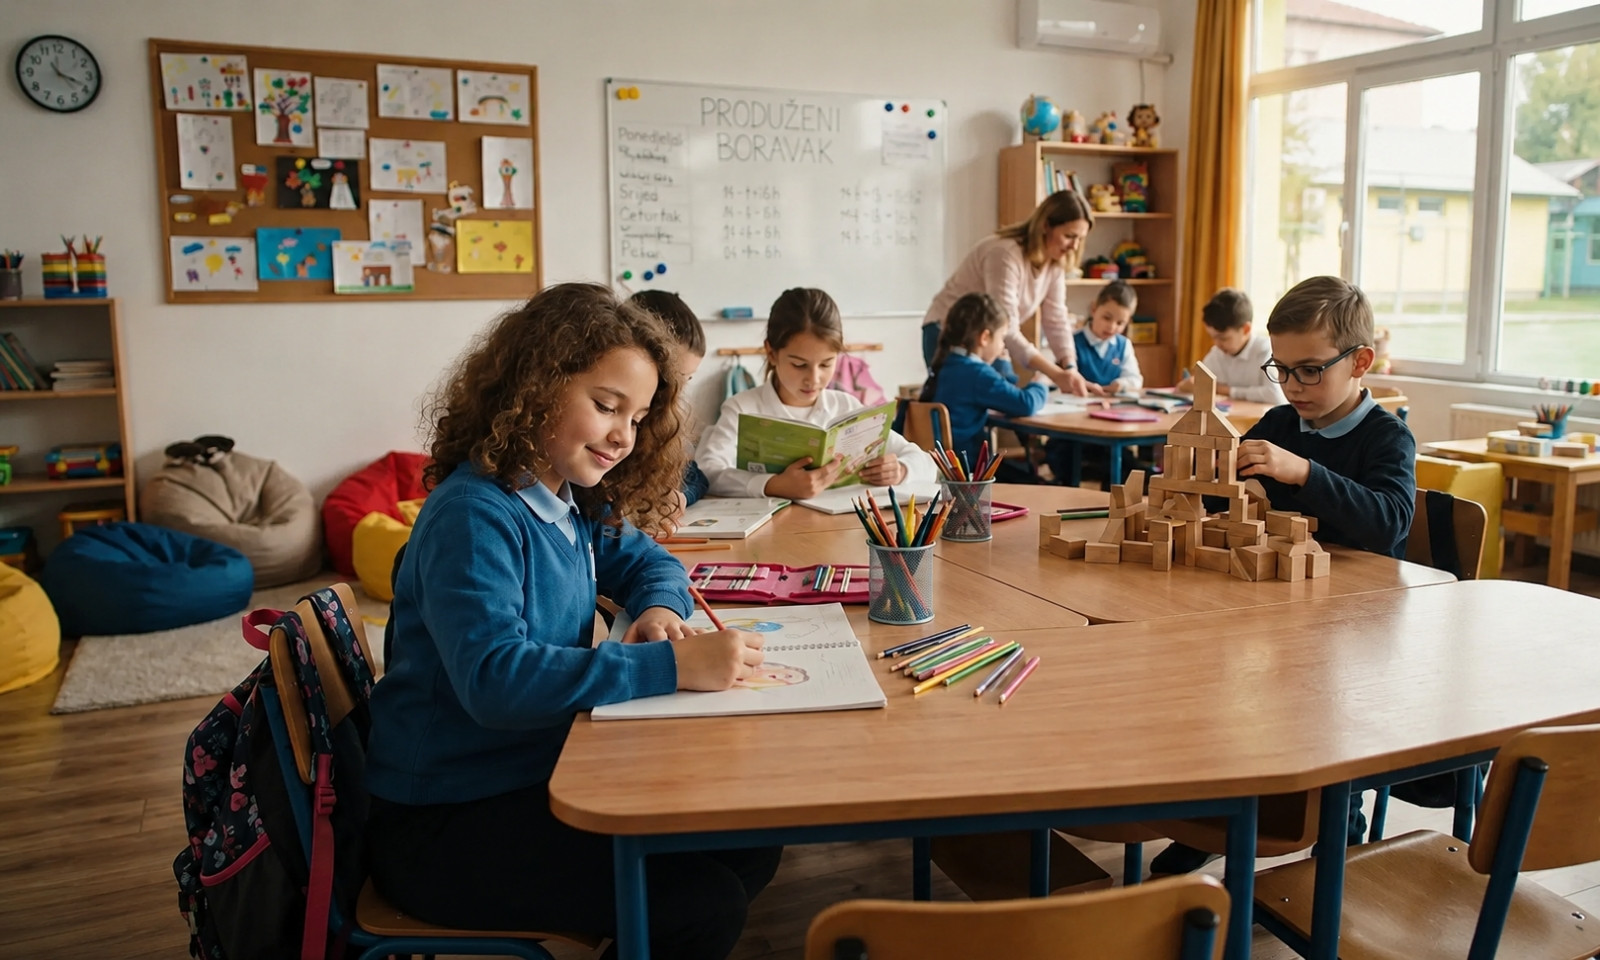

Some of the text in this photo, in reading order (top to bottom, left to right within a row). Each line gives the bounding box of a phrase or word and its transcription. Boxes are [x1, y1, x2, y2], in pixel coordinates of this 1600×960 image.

[40, 43, 49, 56] 11
[53, 43, 64, 54] 12
[30, 54, 42, 65] 10
[80, 58, 88, 68] 2
[26, 67, 34, 77] 9
[85, 70, 93, 81] 3
[32, 81, 40, 91] 8
[81, 84, 89, 94] 4
[44, 90, 51, 101] 7
[57, 95, 65, 105] 6
[71, 92, 79, 103] 5
[700, 96, 841, 133] PRODUŽENI
[716, 131, 834, 165] BORAVAK
